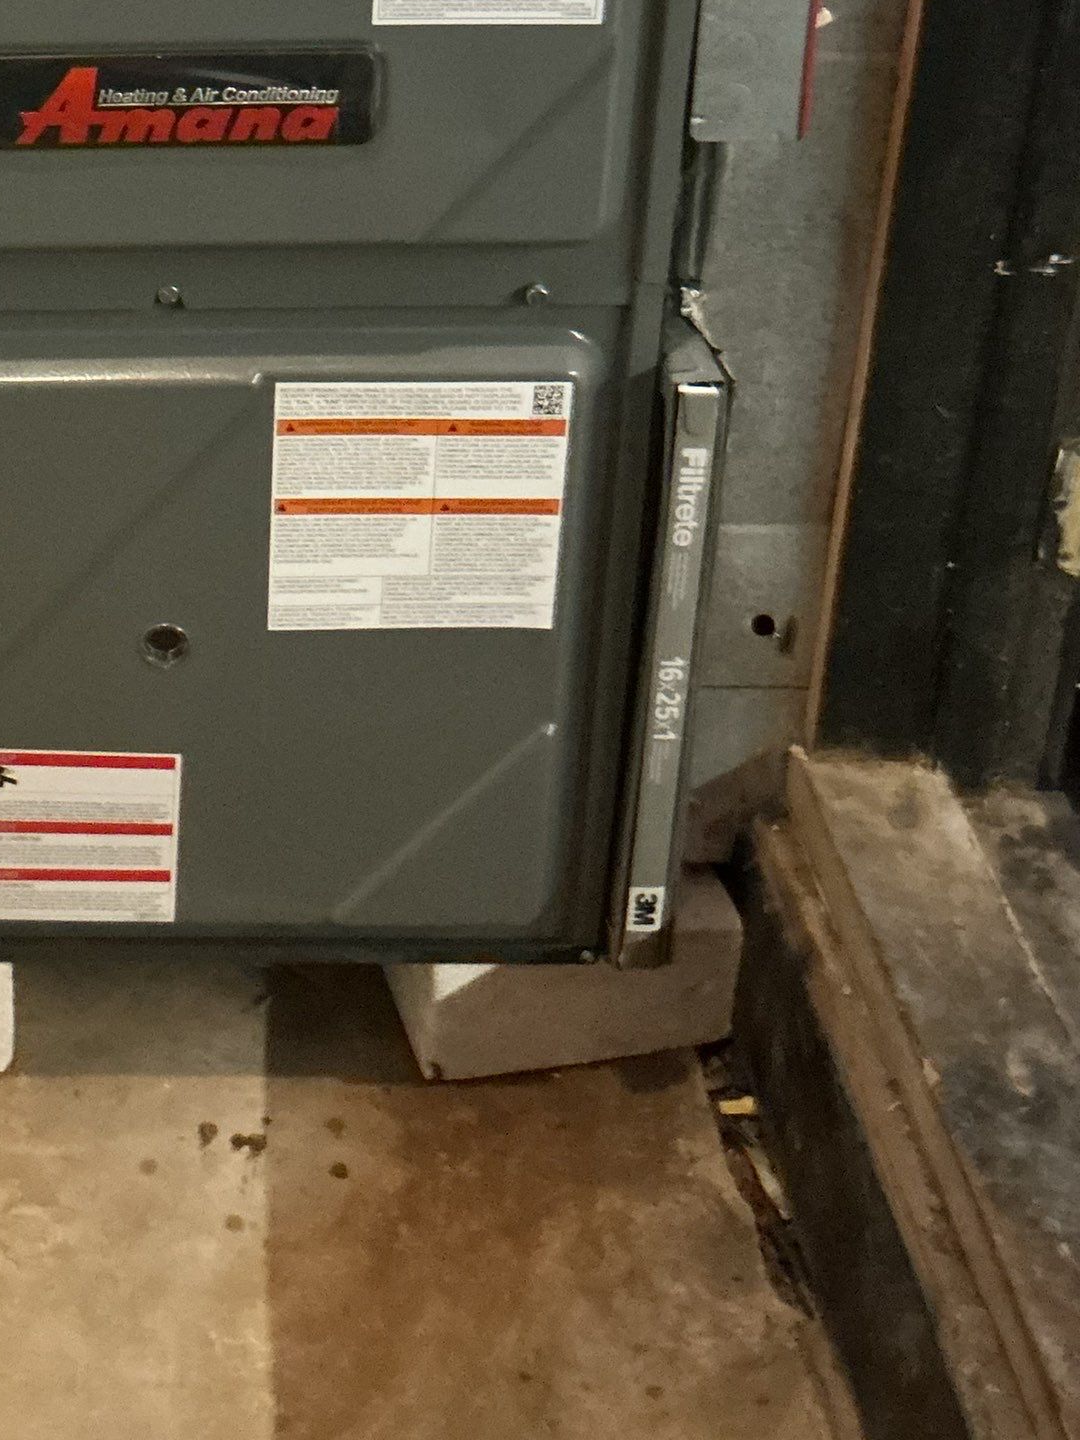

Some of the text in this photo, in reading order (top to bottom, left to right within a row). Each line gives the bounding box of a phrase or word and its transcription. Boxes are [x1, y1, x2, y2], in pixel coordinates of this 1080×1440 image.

[15, 66, 340, 146] Amana
[98, 85, 340, 105] Heating & Air Conditioning
[672, 447, 710, 547] Filtrete
[653, 656, 685, 741] 16x25x1
[633, 893, 658, 926] 3M
